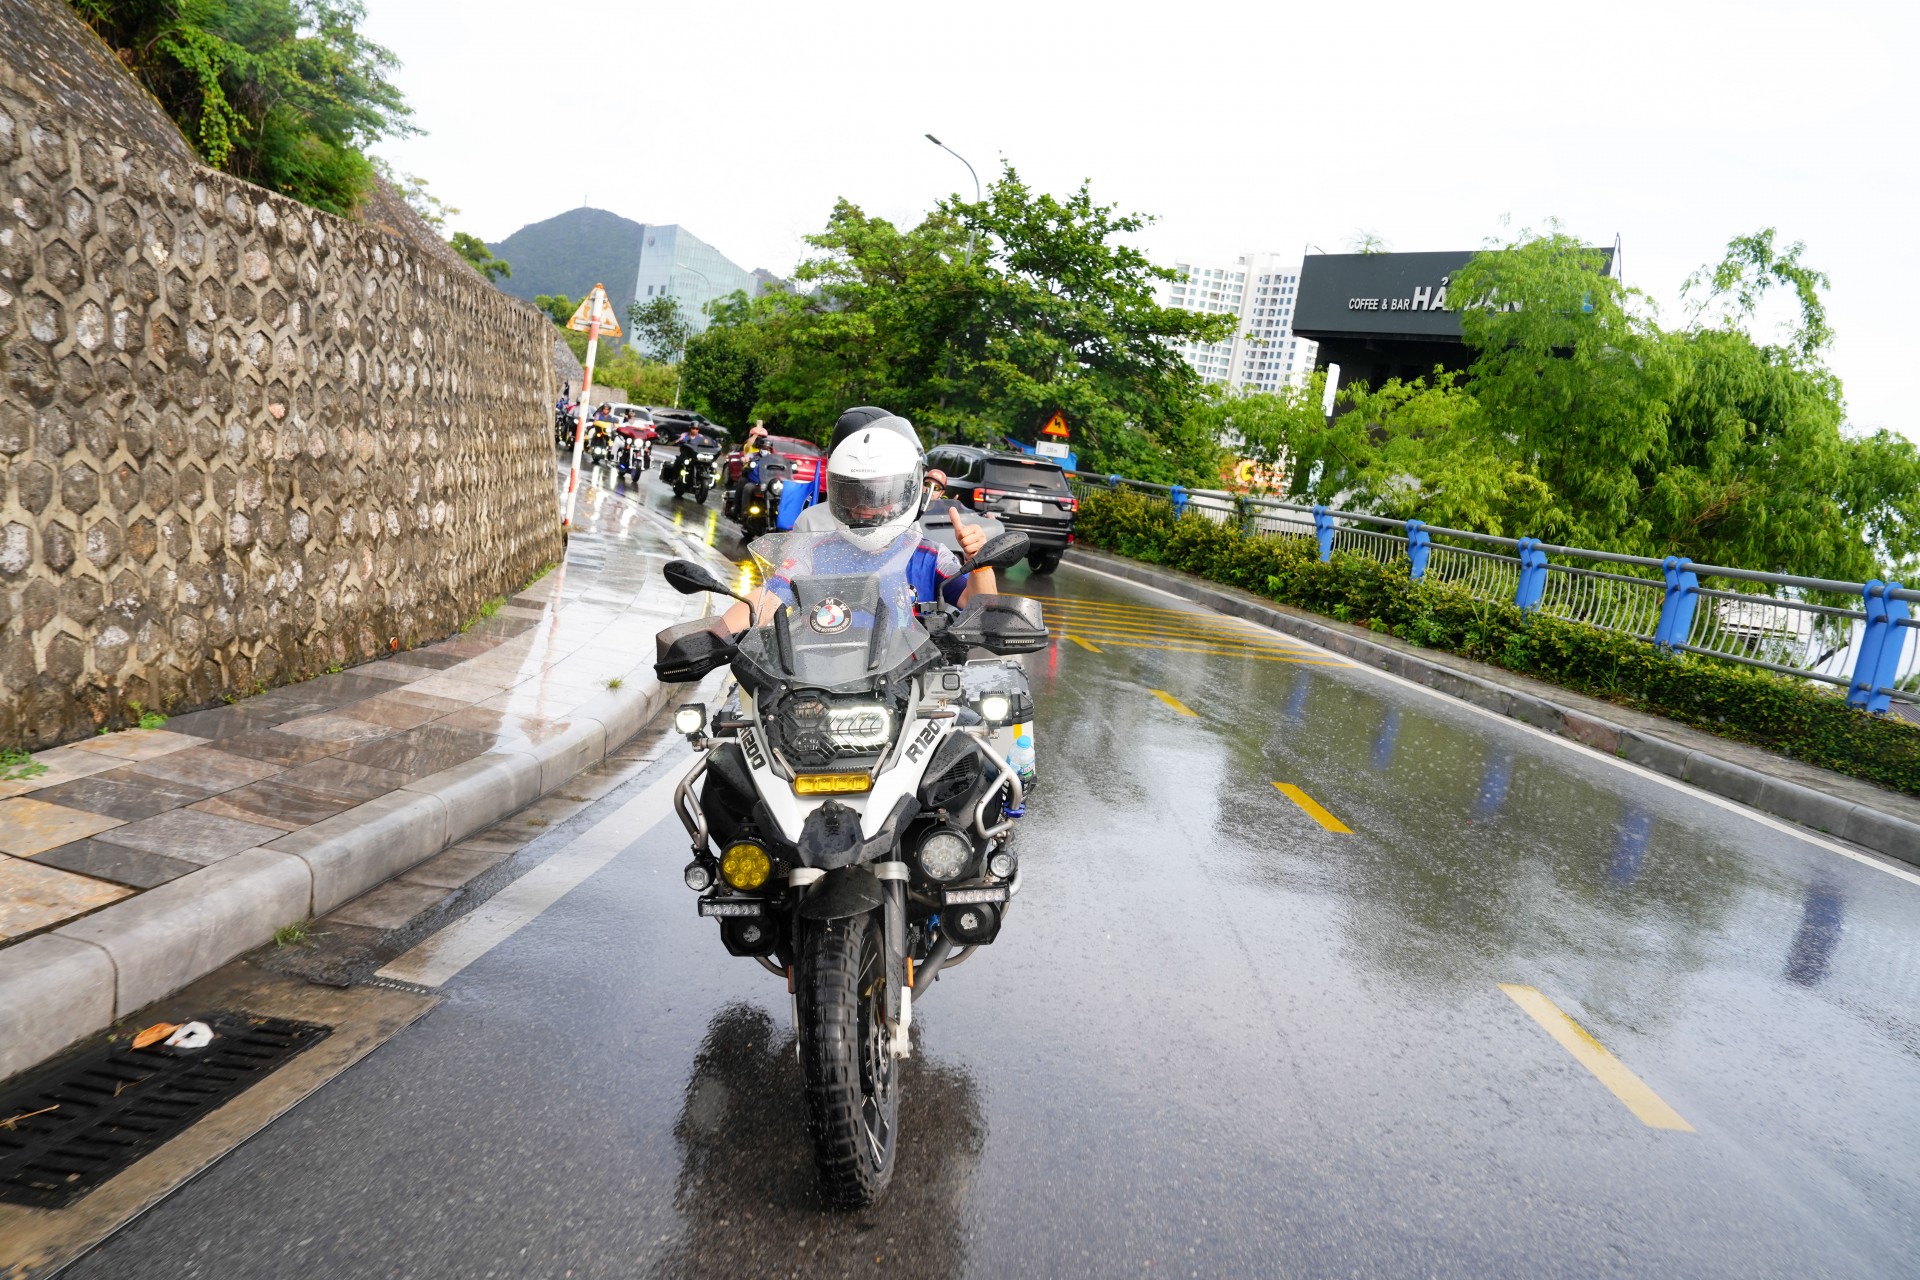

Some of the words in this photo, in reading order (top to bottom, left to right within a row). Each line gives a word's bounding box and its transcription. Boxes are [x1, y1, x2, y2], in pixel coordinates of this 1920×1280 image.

[1348, 298, 1379, 310] COFFEE
[1381, 298, 1388, 310] &
[1390, 298, 1410, 310] BAR
[813, 599, 848, 612] BMW
